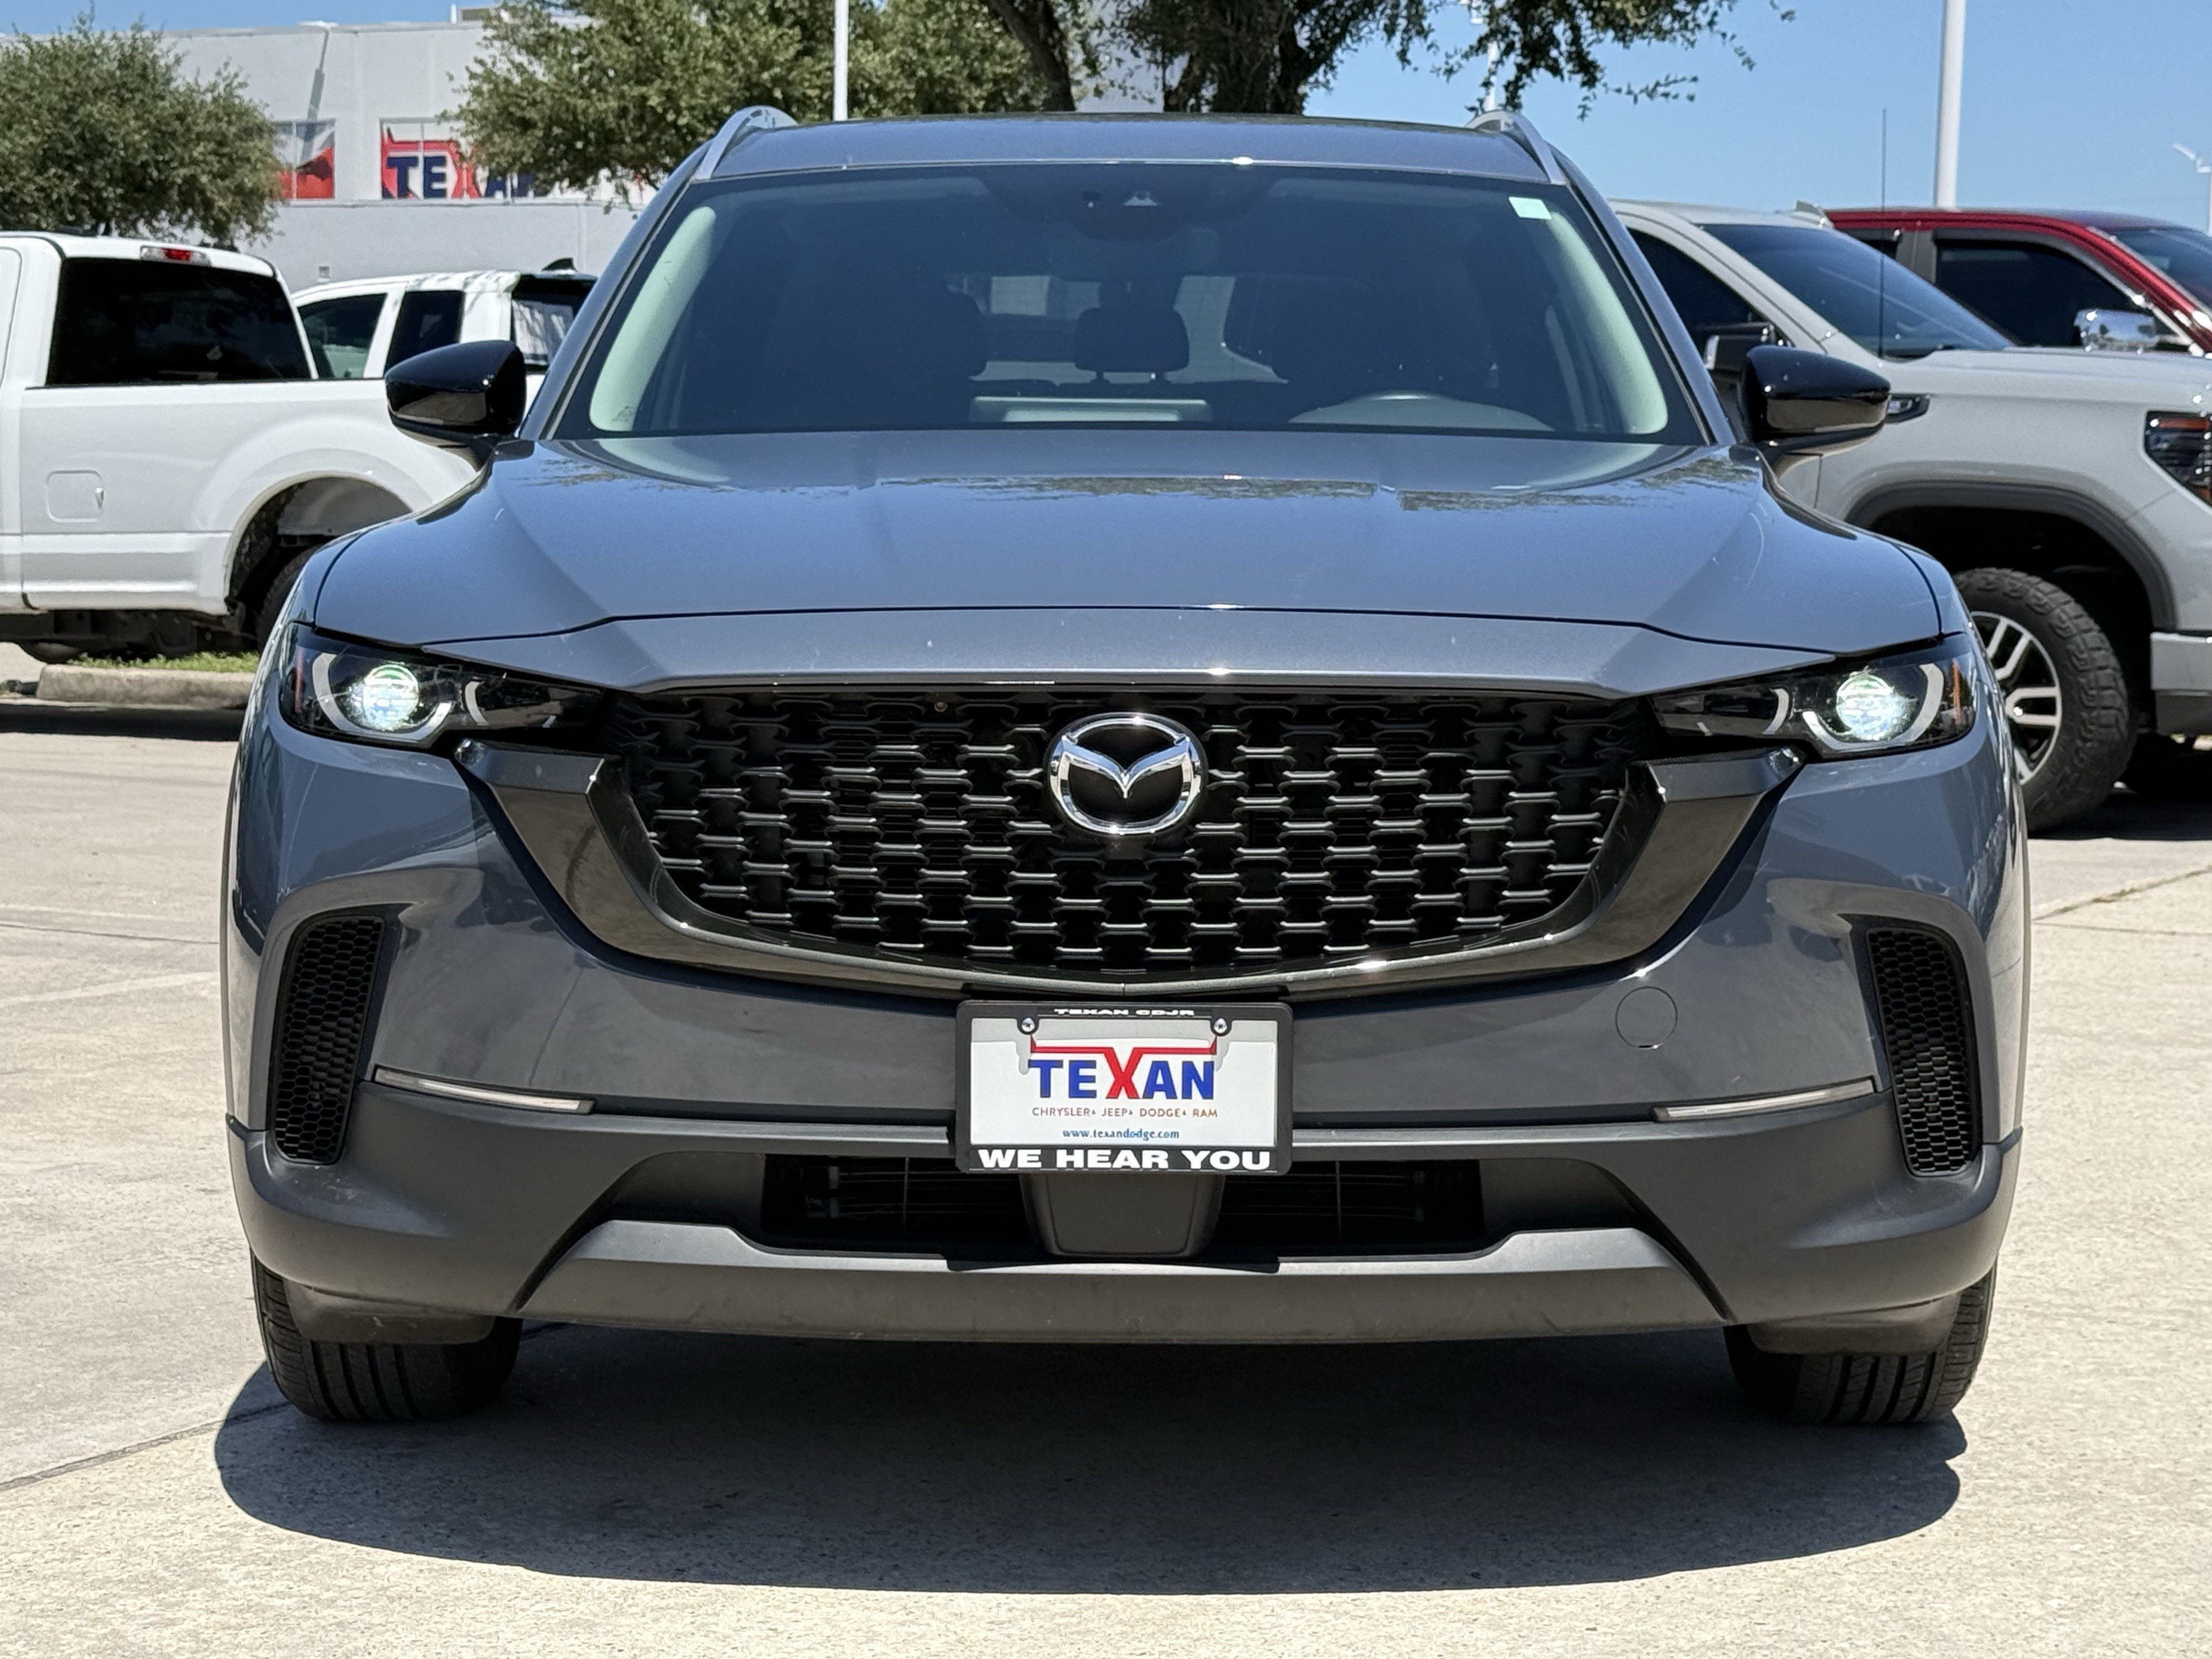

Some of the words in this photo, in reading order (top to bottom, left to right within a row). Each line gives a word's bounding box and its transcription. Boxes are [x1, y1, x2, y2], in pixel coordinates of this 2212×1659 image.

[1028, 1047, 1215, 1100] TEXAN
[1032, 1107, 1090, 1117] CHRYSLER
[1101, 1108, 1128, 1118] JEEP
[1139, 1108, 1181, 1118] DODGE
[1192, 1108, 1218, 1118] RAM
[1062, 1128, 1180, 1141] www.texandodge.com
[978, 1149, 1042, 1169] WE
[1056, 1149, 1170, 1169] HEAR
[1181, 1150, 1271, 1171] YOU
